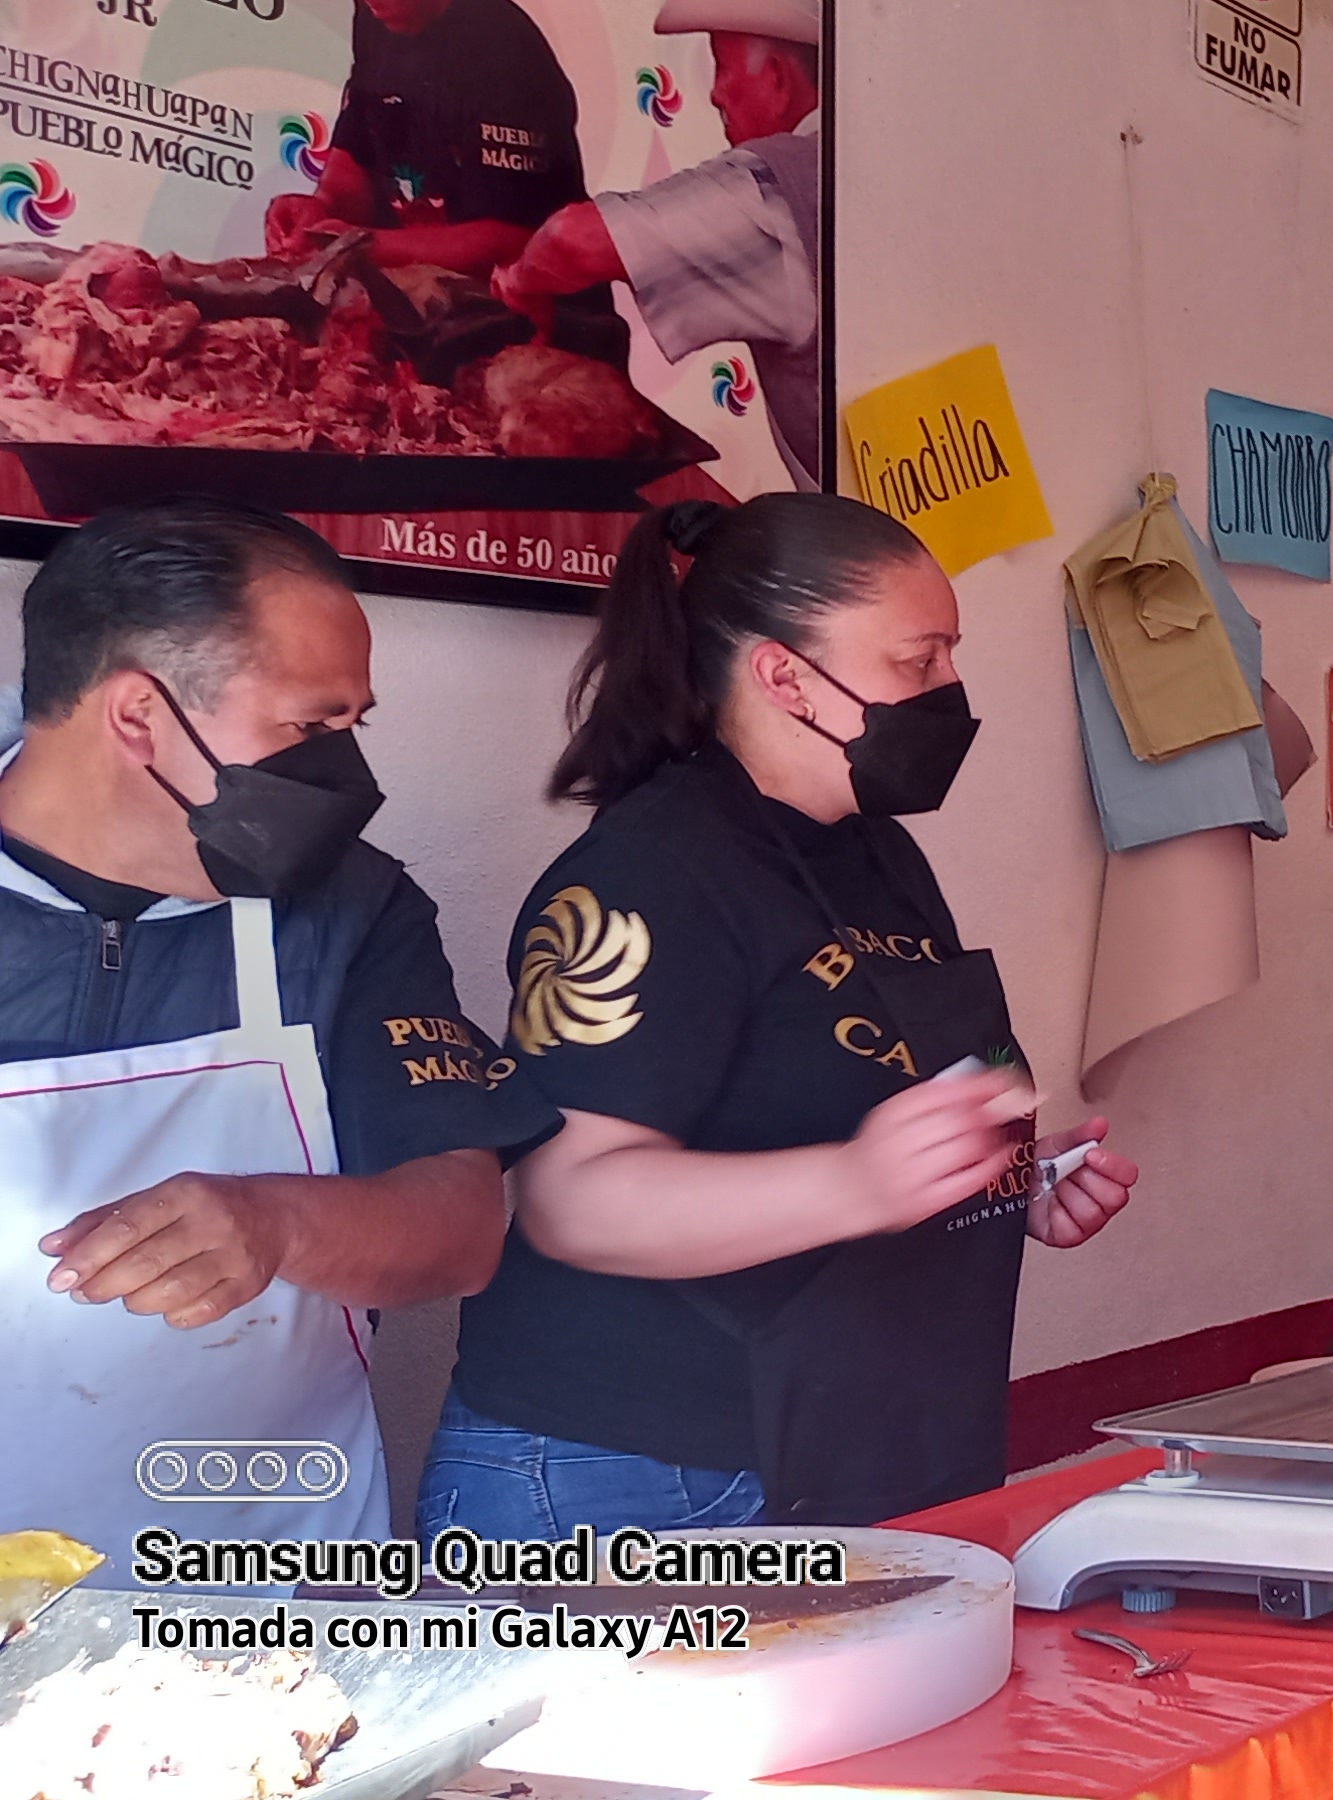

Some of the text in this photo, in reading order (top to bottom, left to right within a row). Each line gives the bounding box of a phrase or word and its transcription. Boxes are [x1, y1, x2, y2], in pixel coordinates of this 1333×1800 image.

[1234, 16, 1266, 54] NO
[1206, 33, 1291, 100] FUMAR
[1212, 424, 1331, 543] CHAMORRO
[380, 518, 618, 578] Más de 50 año
[947, 1198, 1029, 1231] CHIGNAHU
